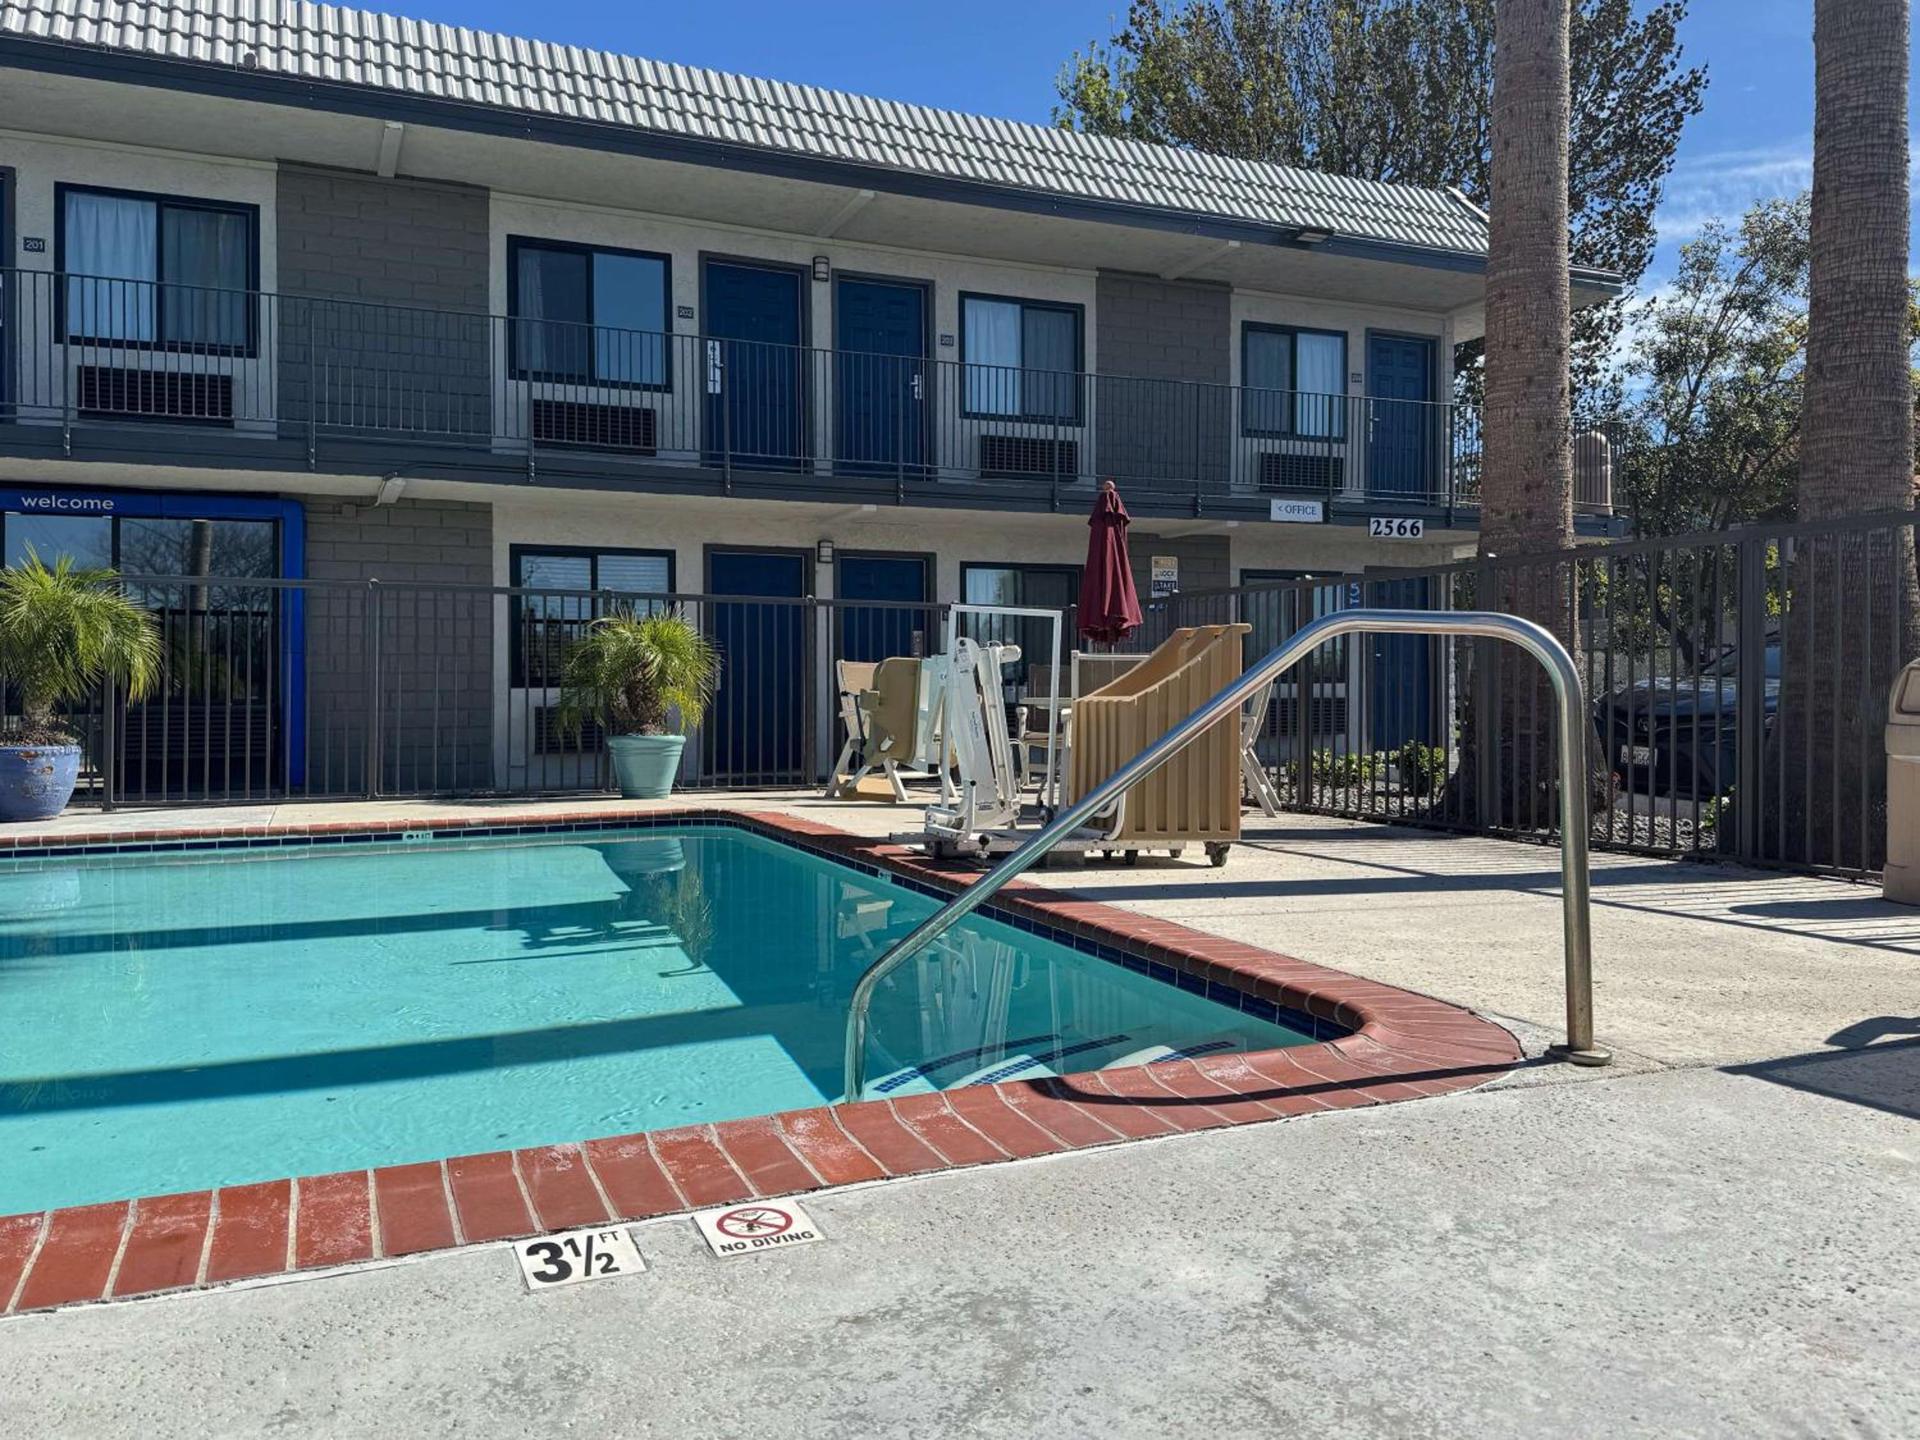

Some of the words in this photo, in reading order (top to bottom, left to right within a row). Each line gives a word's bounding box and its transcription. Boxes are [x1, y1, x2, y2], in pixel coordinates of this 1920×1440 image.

[25, 239, 43, 250] 201
[20, 494, 114, 510] welcome
[1285, 504, 1317, 515] OFFICE
[1372, 519, 1420, 536] 2566
[599, 1230, 619, 1243] FT
[719, 1241, 747, 1253] NO
[750, 1230, 815, 1249] DIVING
